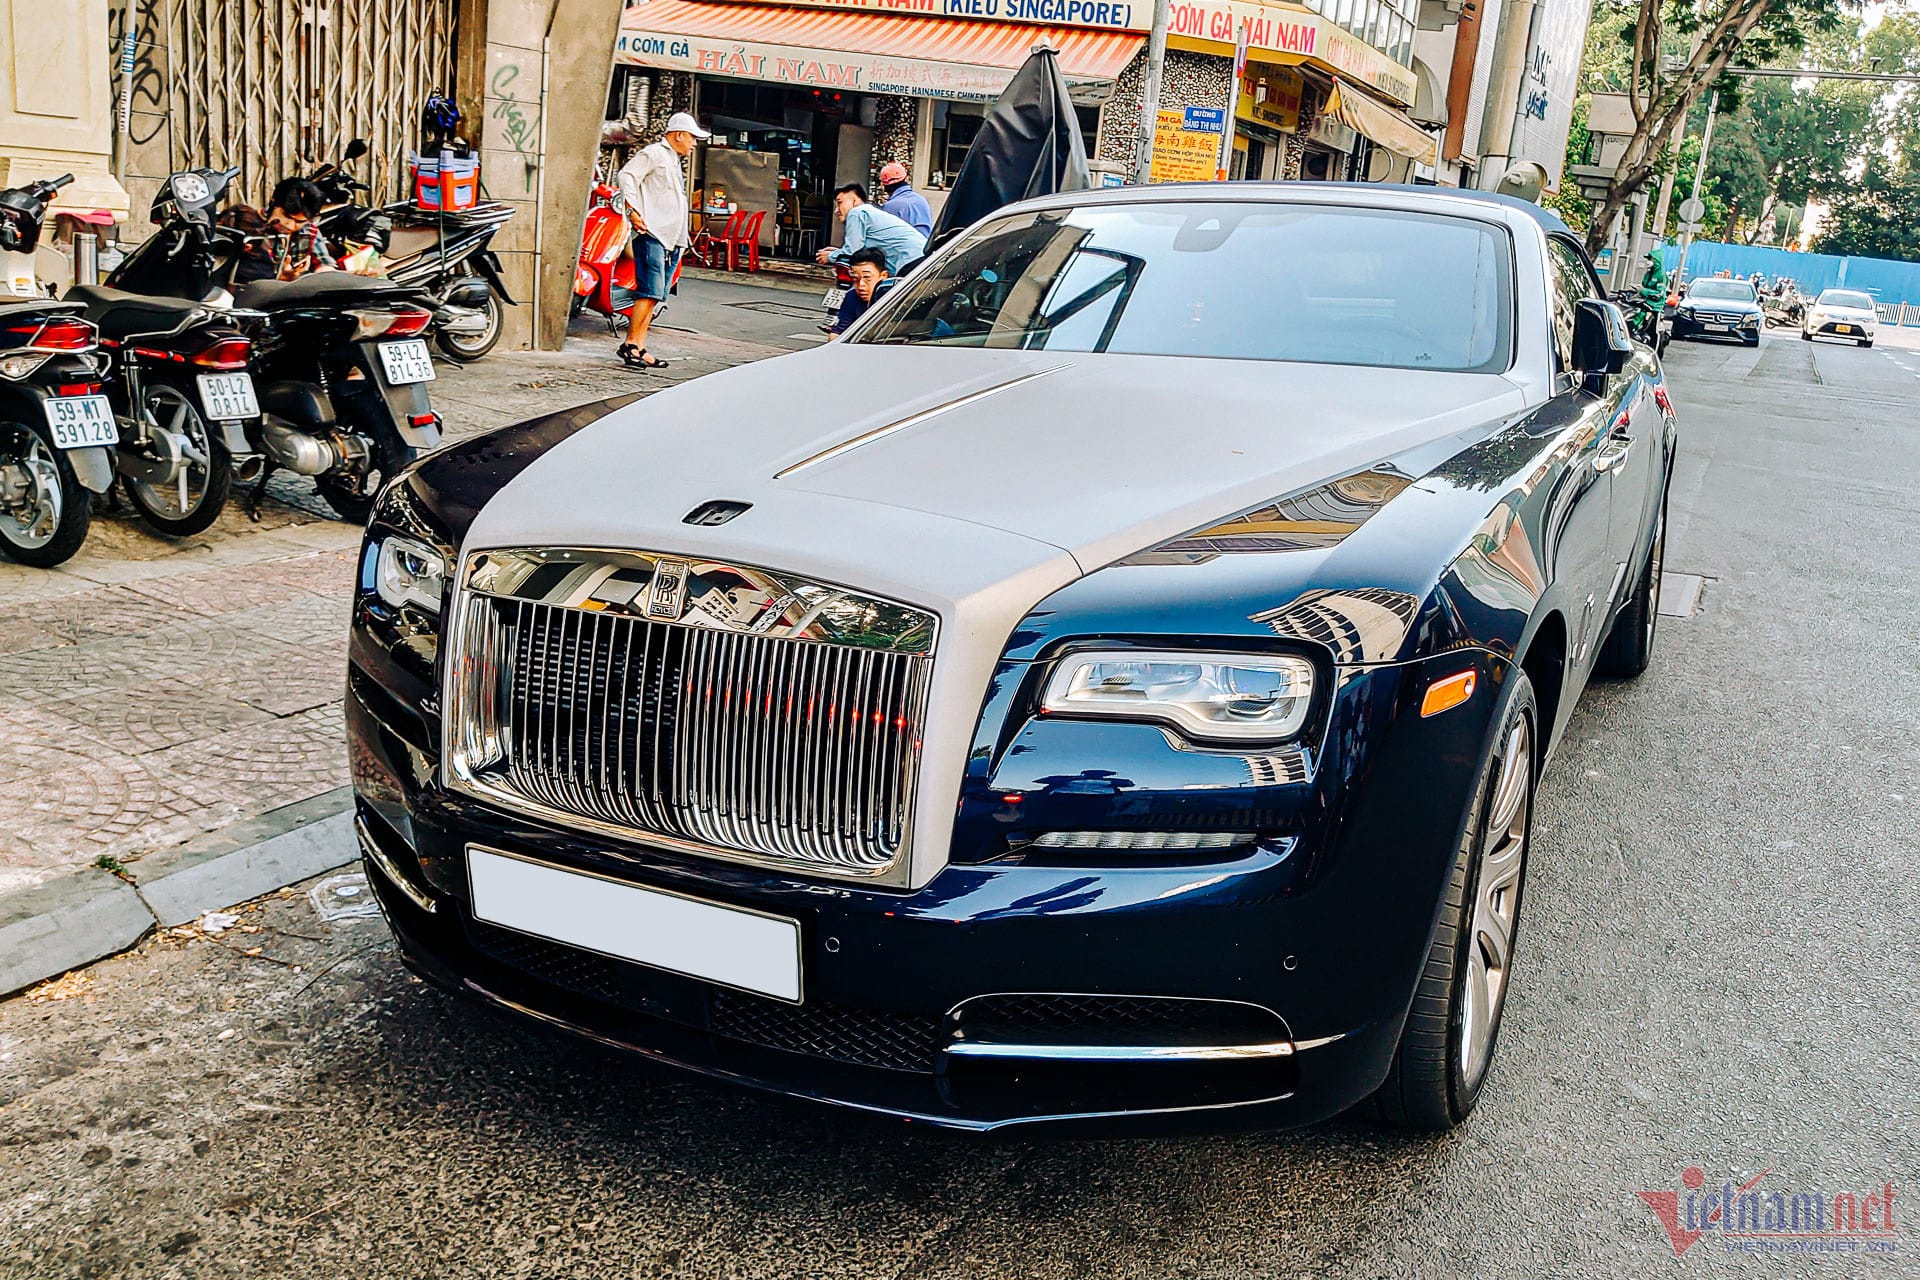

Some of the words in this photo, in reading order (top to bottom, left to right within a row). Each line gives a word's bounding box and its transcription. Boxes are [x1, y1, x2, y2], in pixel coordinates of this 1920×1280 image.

[1005, 0, 1131, 28] SINGAPORE)
[1167, 2, 1205, 35] CƠM
[1210, 5, 1233, 40] GÀ
[1276, 22, 1315, 54] NAM
[632, 37, 665, 55] CƠM
[670, 38, 689, 58] GÀ
[696, 44, 766, 79] HẢI
[775, 57, 862, 89] NAM
[868, 82, 909, 95] SINGAPORE
[55, 421, 113, 444] 591.28
